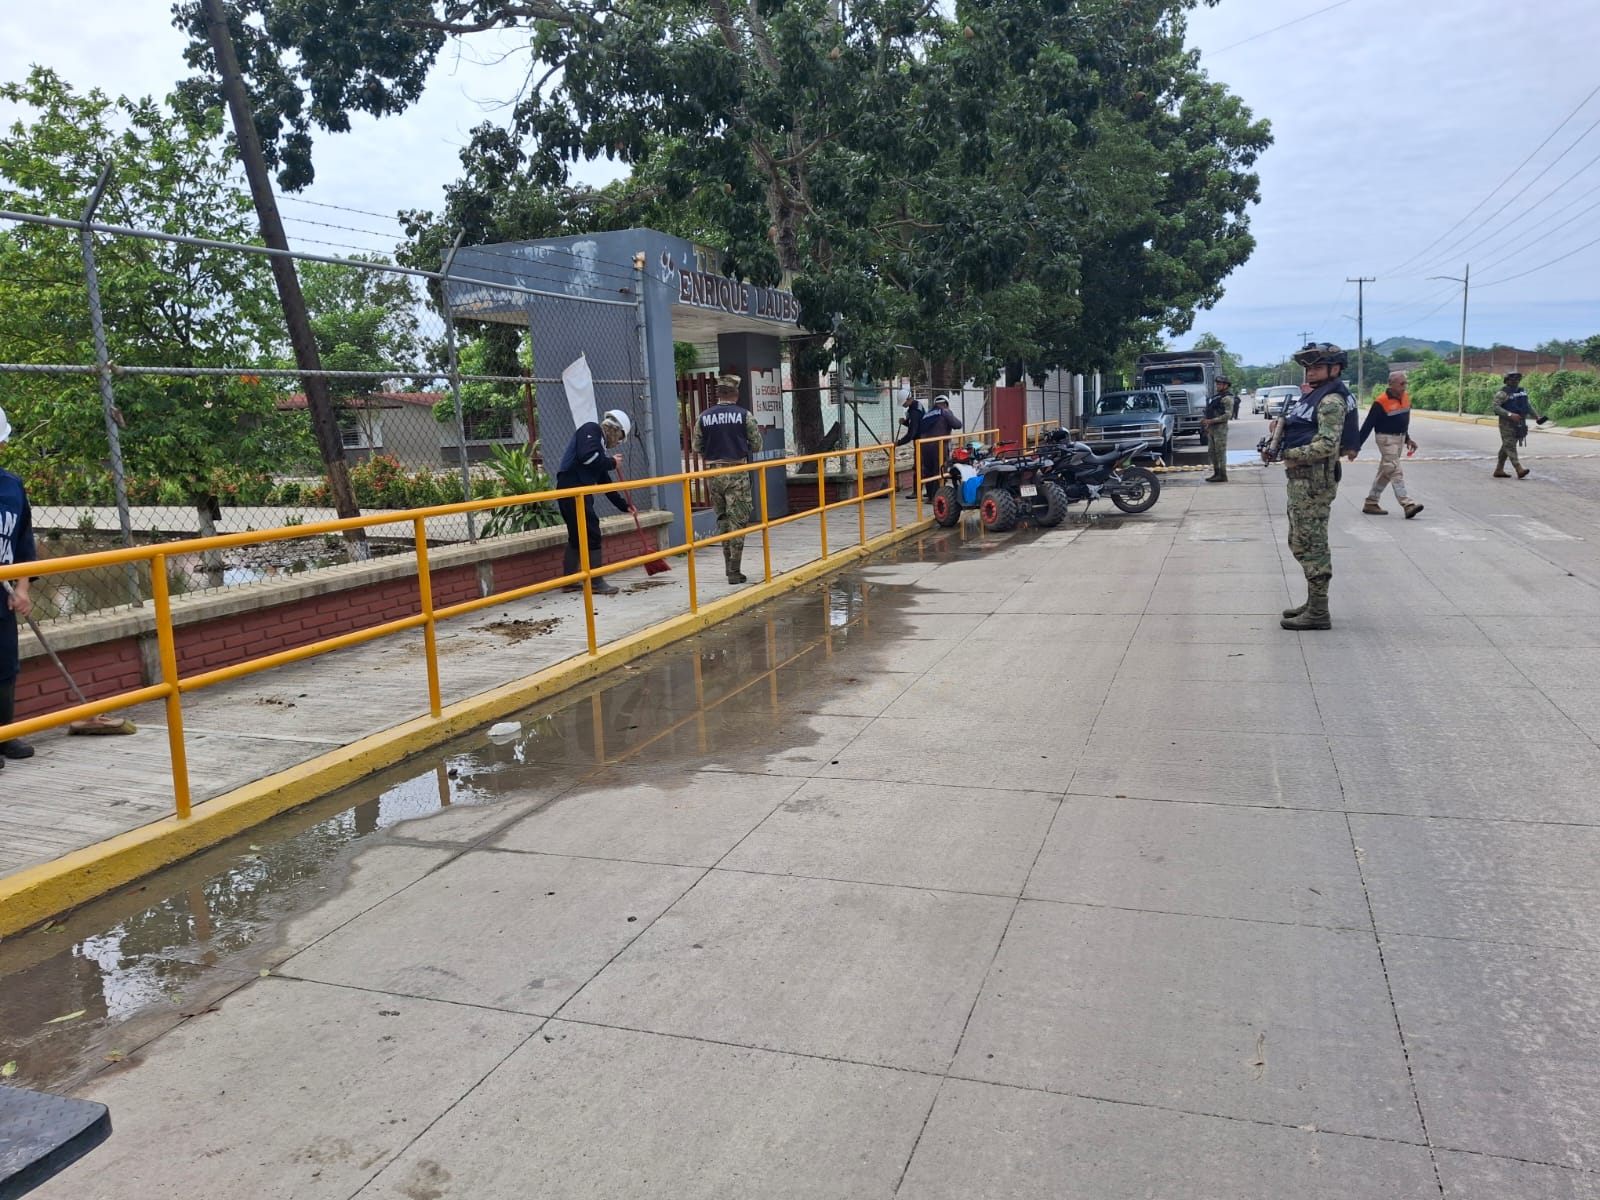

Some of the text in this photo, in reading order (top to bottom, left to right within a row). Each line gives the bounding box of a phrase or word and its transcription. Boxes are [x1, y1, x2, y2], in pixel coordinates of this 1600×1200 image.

[678, 269, 800, 323] ENRIQUE LAUBS
[702, 411, 743, 427] MARINA
